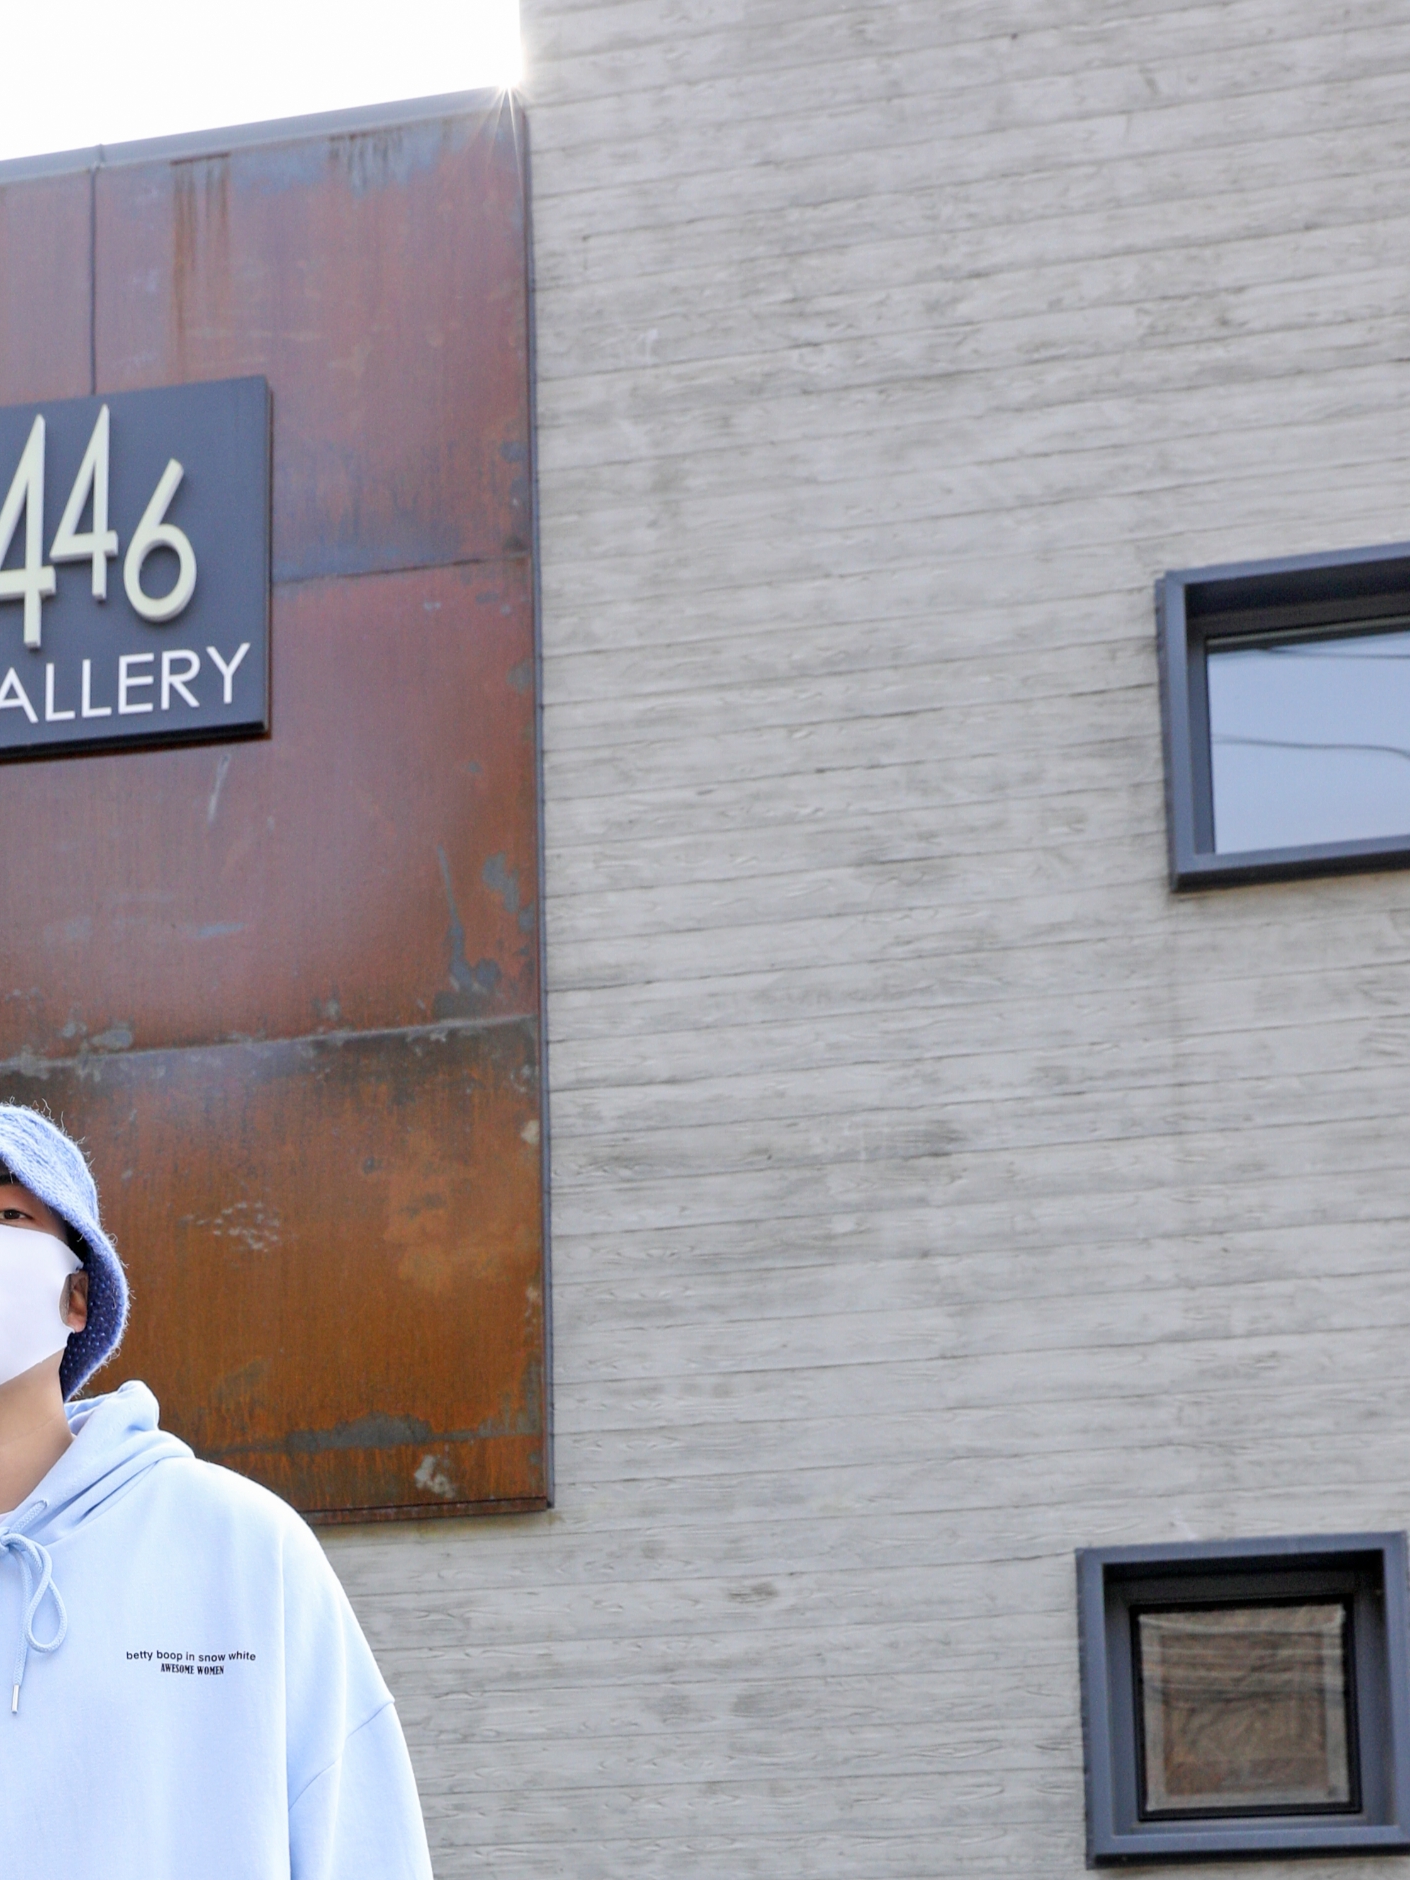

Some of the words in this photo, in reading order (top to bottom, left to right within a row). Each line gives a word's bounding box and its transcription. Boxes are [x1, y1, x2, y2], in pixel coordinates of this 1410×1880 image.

[126, 1650, 153, 1661] betty
[156, 1650, 183, 1662] boop
[185, 1651, 195, 1661] in
[198, 1653, 226, 1662] snow
[228, 1651, 256, 1661] white
[160, 1663, 194, 1674] AWESOME
[197, 1665, 224, 1675] WOMEN
